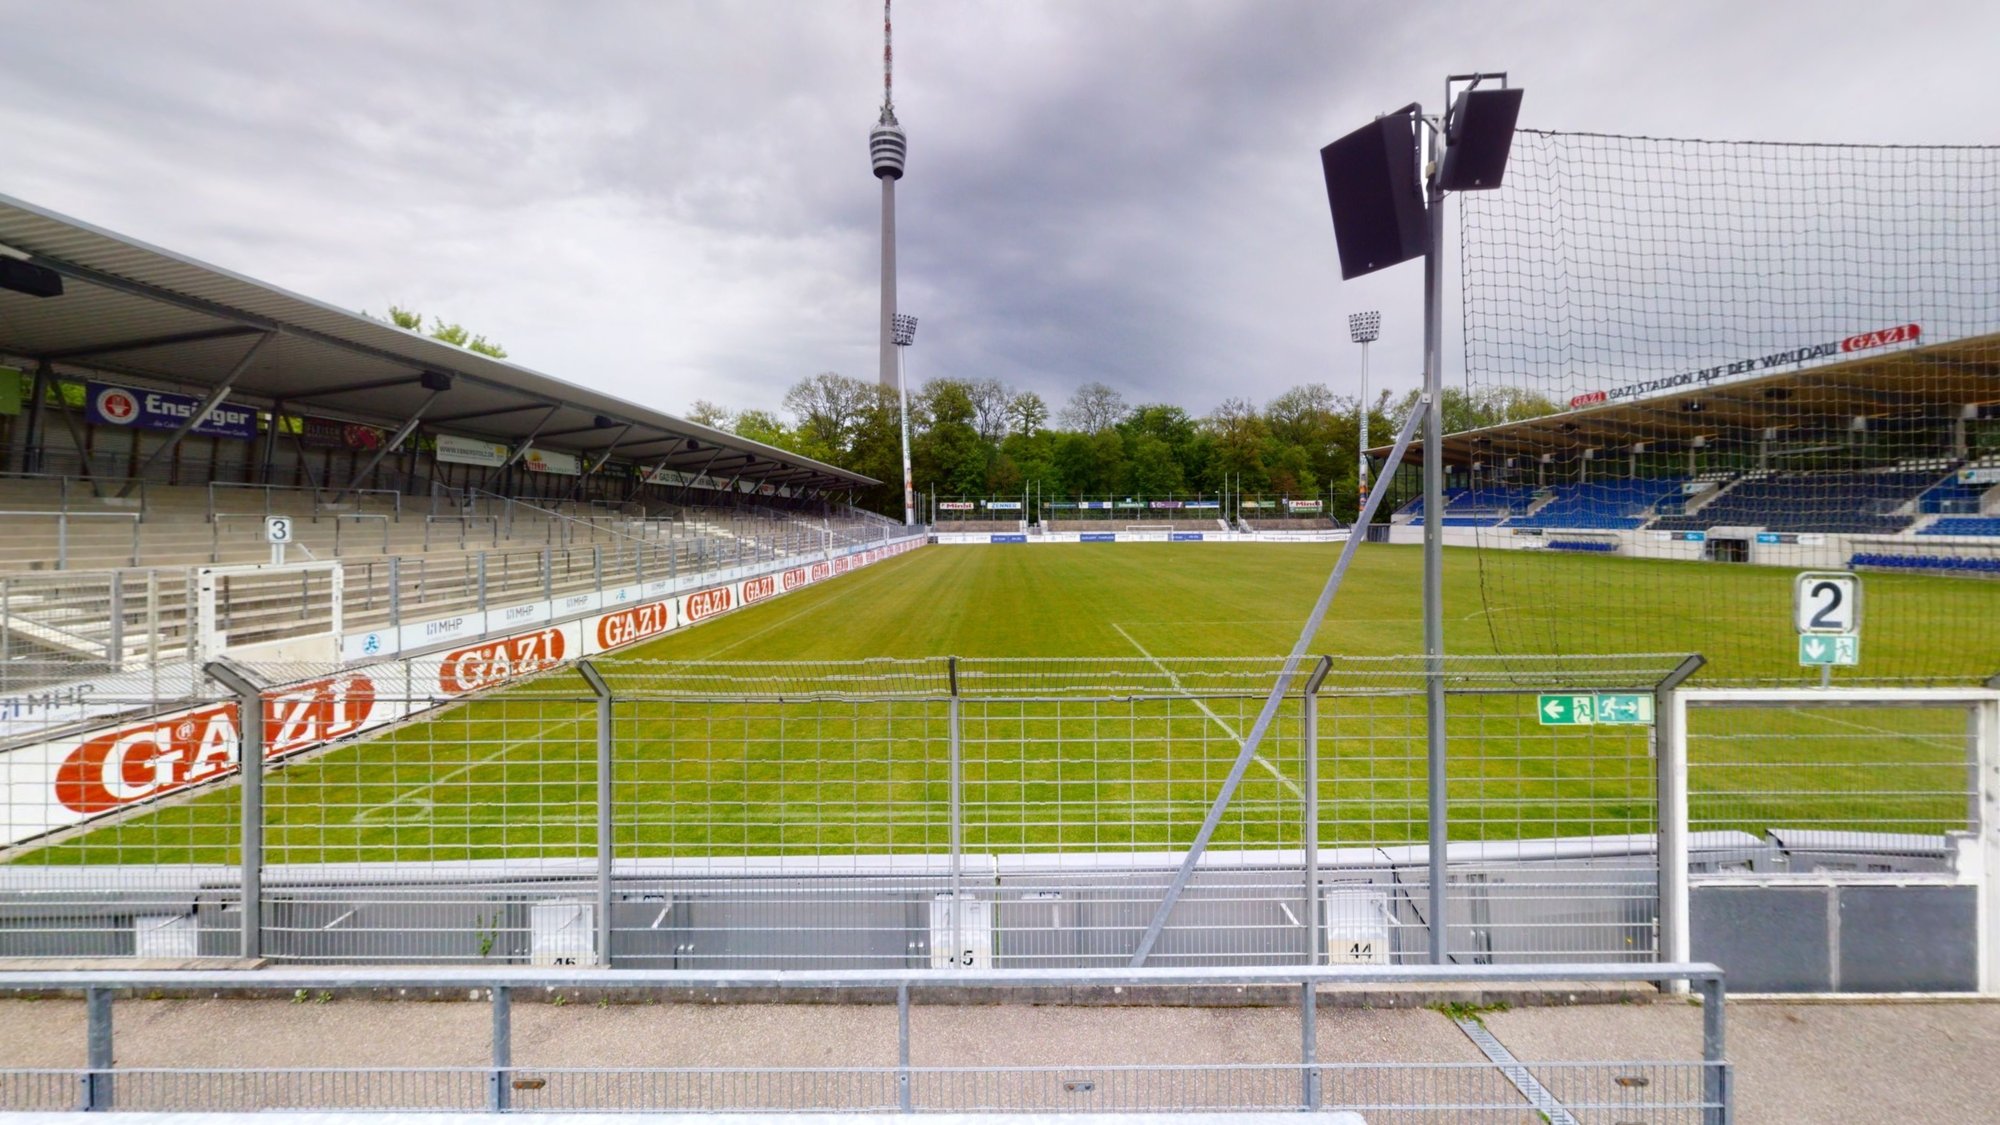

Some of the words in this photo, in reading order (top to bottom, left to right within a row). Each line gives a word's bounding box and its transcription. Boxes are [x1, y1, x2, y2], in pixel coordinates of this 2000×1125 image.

[1609, 384, 1636, 399] GAZI
[1638, 372, 1692, 394] STADION
[1697, 366, 1722, 382] AUF
[1728, 359, 1755, 375] DER
[1761, 343, 1837, 368] WALDAU
[1850, 326, 1911, 350] GAZI
[272, 520, 286, 540] 3
[746, 577, 773, 601] GAZI
[785, 568, 804, 589] GAZI
[515, 605, 534, 617] MHP
[690, 588, 728, 620] GAZI
[1810, 581, 1842, 628] 2
[438, 618, 463, 633] MHP
[605, 602, 663, 646] GAZI
[455, 632, 556, 690] GAZI
[28, 684, 95, 714] MHP
[1350, 943, 1372, 959] 44
